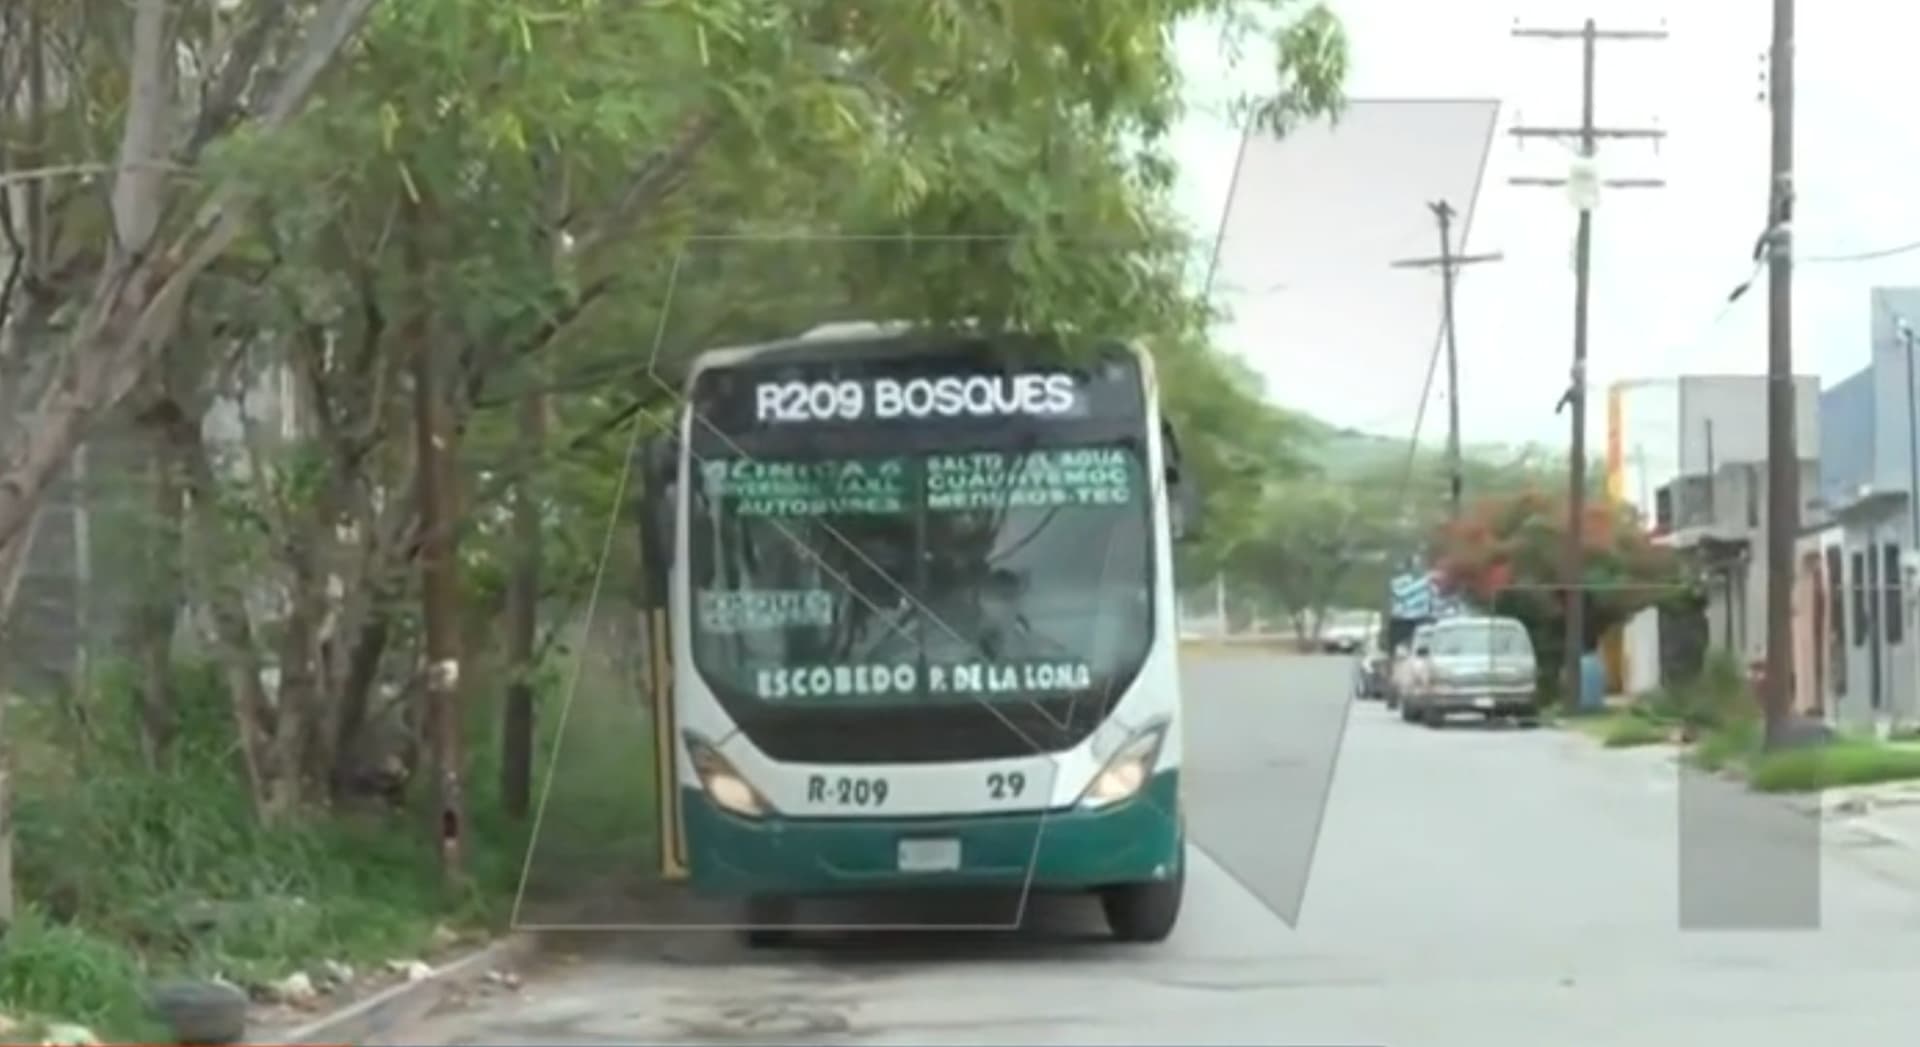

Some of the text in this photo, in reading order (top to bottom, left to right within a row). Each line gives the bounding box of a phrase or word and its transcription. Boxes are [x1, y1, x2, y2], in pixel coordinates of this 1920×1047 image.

[757, 372, 1075, 421] R209 BOSQUES
[757, 664, 917, 698] ESCOBEDO
[953, 663, 983, 692] DE
[988, 664, 1018, 692] LA
[807, 775, 889, 806] R-209
[986, 771, 1026, 799] 29
